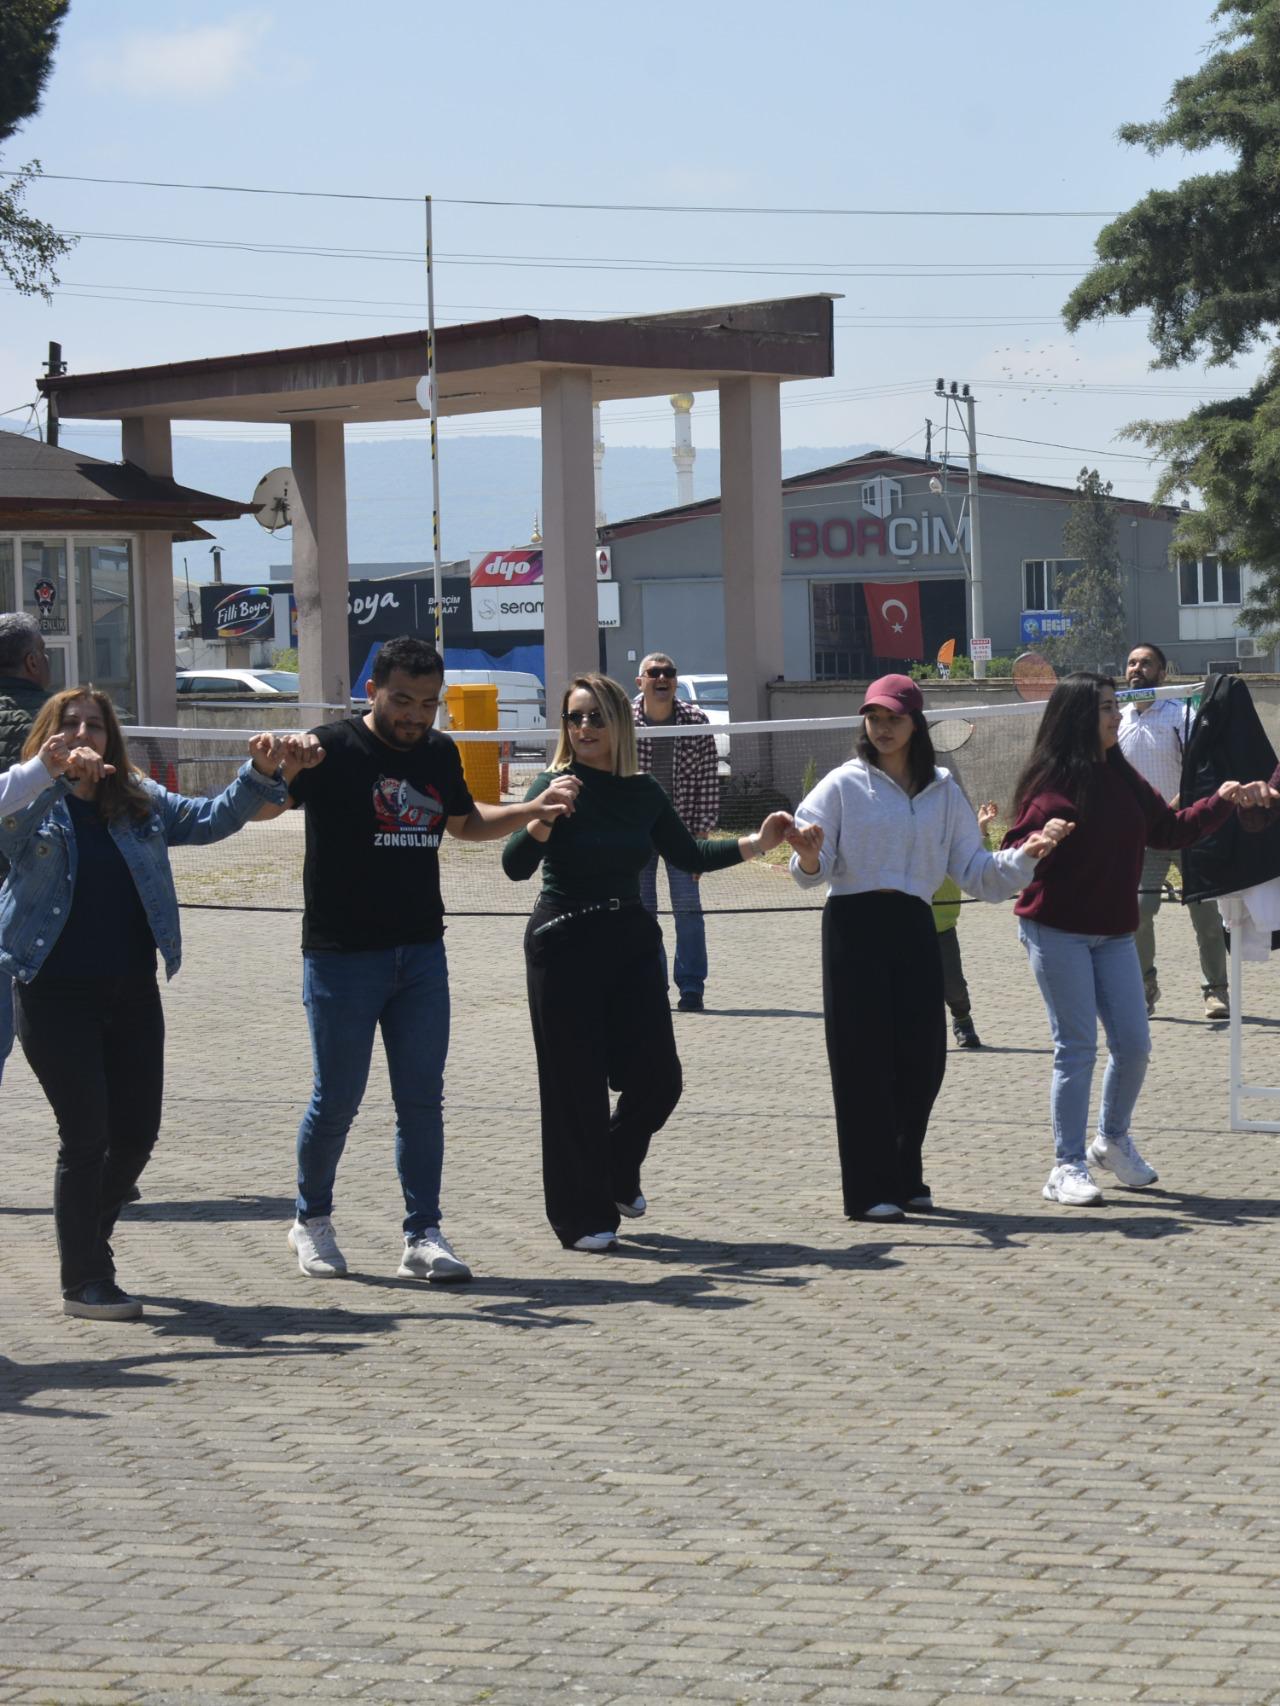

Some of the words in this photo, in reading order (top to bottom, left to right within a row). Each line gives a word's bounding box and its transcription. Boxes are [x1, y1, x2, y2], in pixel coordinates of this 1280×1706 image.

[790, 511, 971, 564] BORÇİM
[485, 556, 530, 580] dyo
[428, 597, 460, 605] BRÇİM
[500, 601, 544, 614] seram
[217, 604, 237, 624] Filli
[240, 602, 269, 619] Boya
[428, 606, 458, 614] İNAAT
[374, 833, 440, 847] ZONGULDAK
